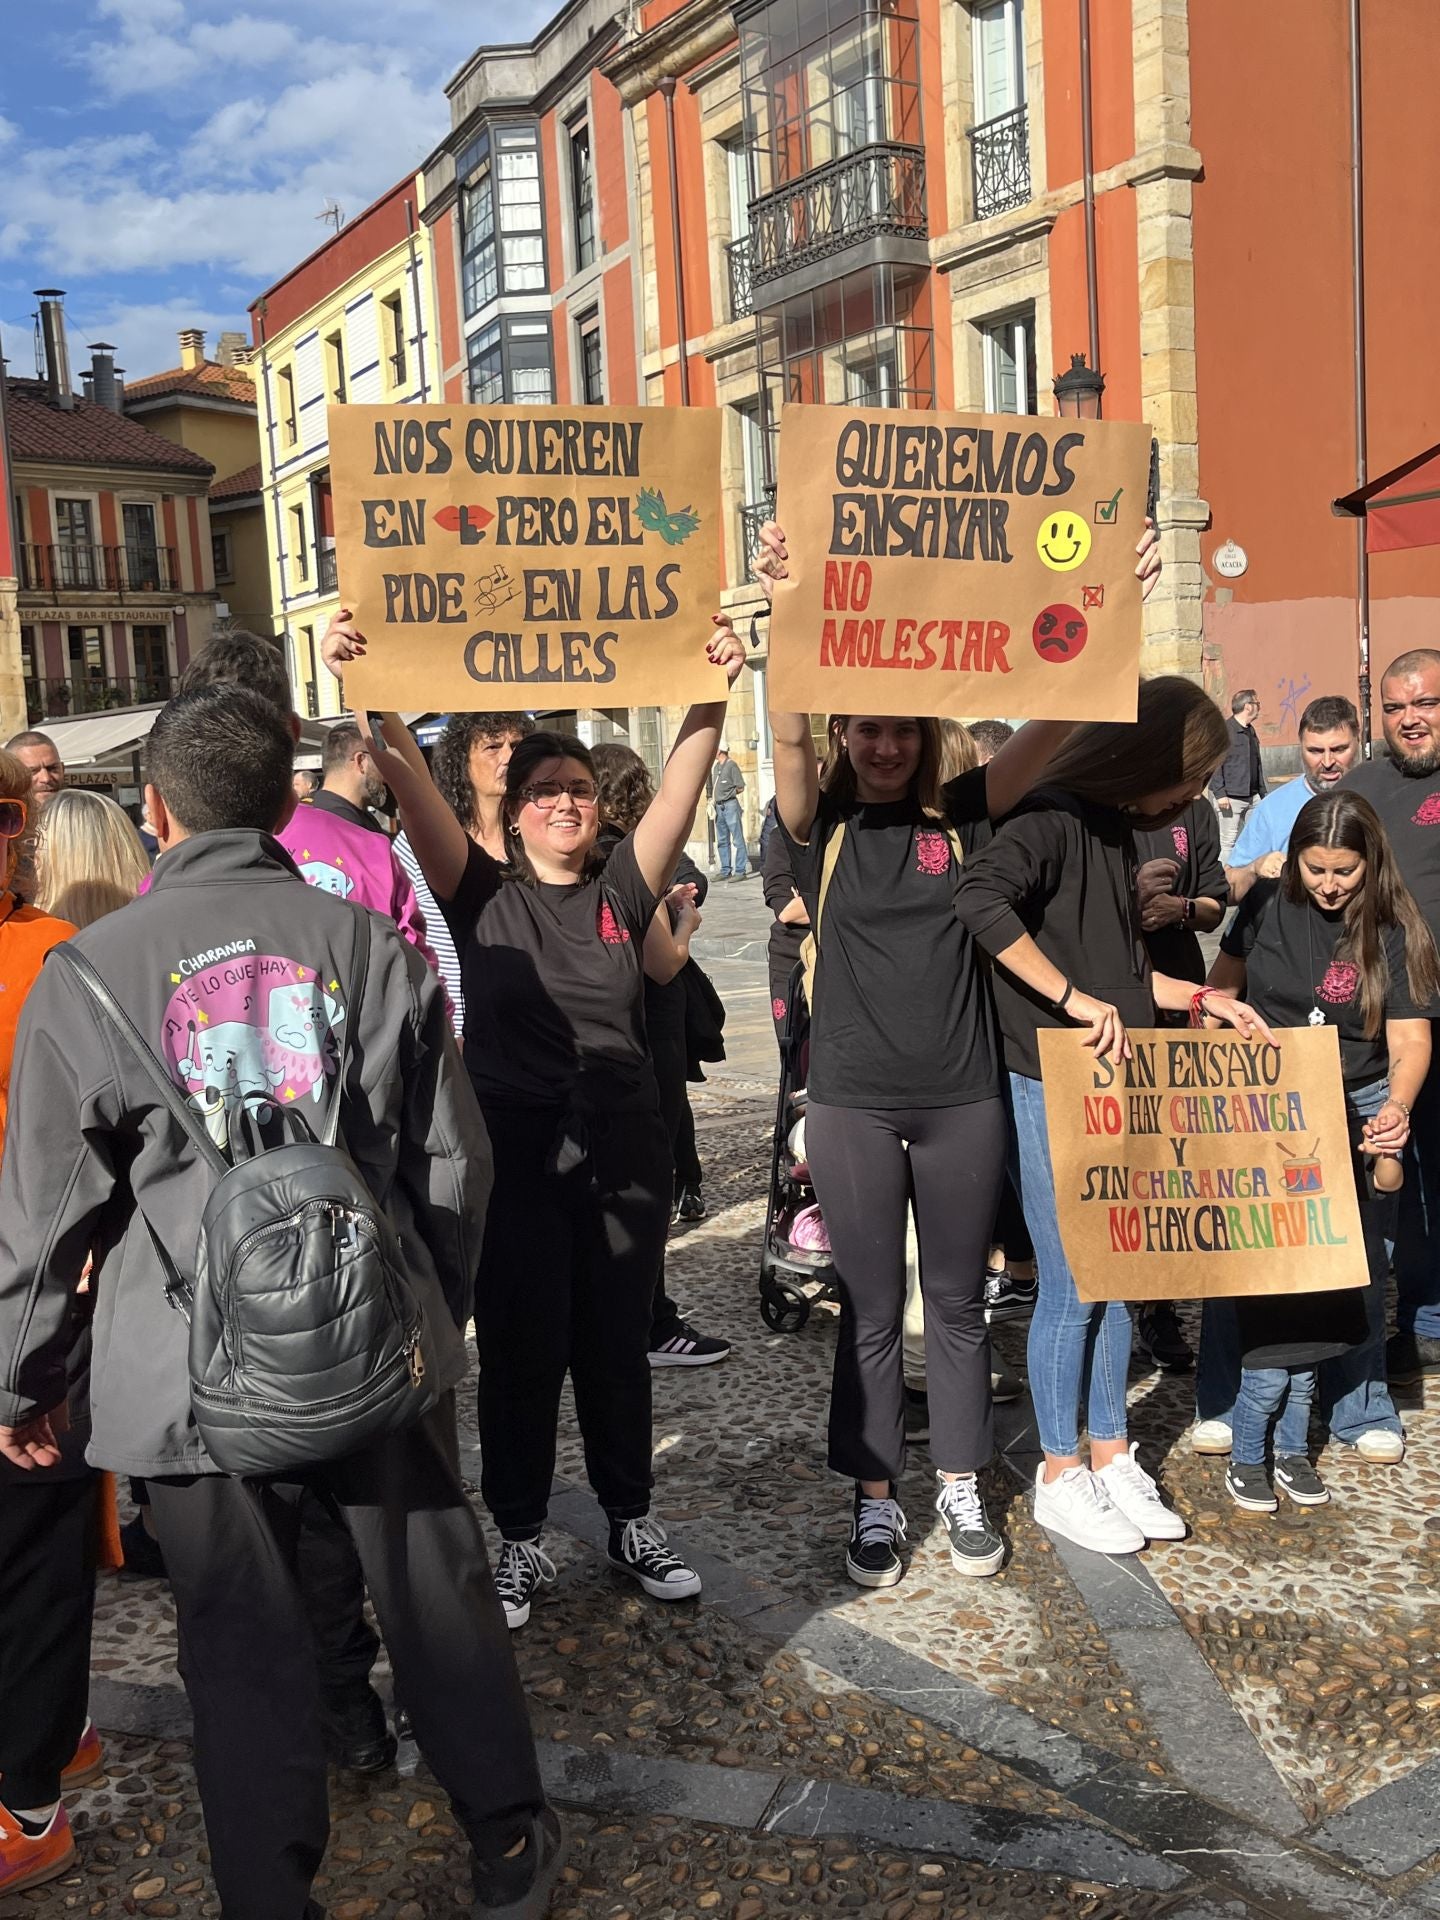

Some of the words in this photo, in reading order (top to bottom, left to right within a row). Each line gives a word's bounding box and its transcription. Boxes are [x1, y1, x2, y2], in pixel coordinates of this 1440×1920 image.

[373, 418, 452, 474] NOS
[465, 419, 643, 476] QUIEREN
[836, 420, 1085, 496] QUEREMOS
[361, 499, 426, 547] EN
[495, 496, 578, 545] PERO
[584, 497, 644, 545] EL
[828, 493, 1014, 563] ENSAYAR
[382, 572, 467, 623] PIDE
[523, 568, 581, 622] EN
[596, 564, 681, 620] LAS
[823, 560, 873, 612] NO
[463, 631, 619, 683] CALLES
[819, 618, 1014, 674] MOLESTAR
[179, 938, 257, 975] CHARANGA
[176, 988, 200, 1009] YE
[202, 976, 221, 995] LO
[224, 964, 255, 985] QUE
[260, 961, 289, 976] HAY
[1093, 1043, 1156, 1088] SIN
[1166, 1041, 1281, 1088] ENSAYO
[1083, 1095, 1122, 1135] NO
[1128, 1094, 1163, 1134] HAY
[1170, 1091, 1308, 1134] CHARANGA
[1169, 1137, 1188, 1167] Y
[1080, 1165, 1129, 1201] SIN
[1132, 1166, 1271, 1200] CHARANGA
[1108, 1205, 1142, 1252] NO
[1144, 1204, 1194, 1252] HAY
[1193, 1196, 1348, 1252] CARNAVAL
